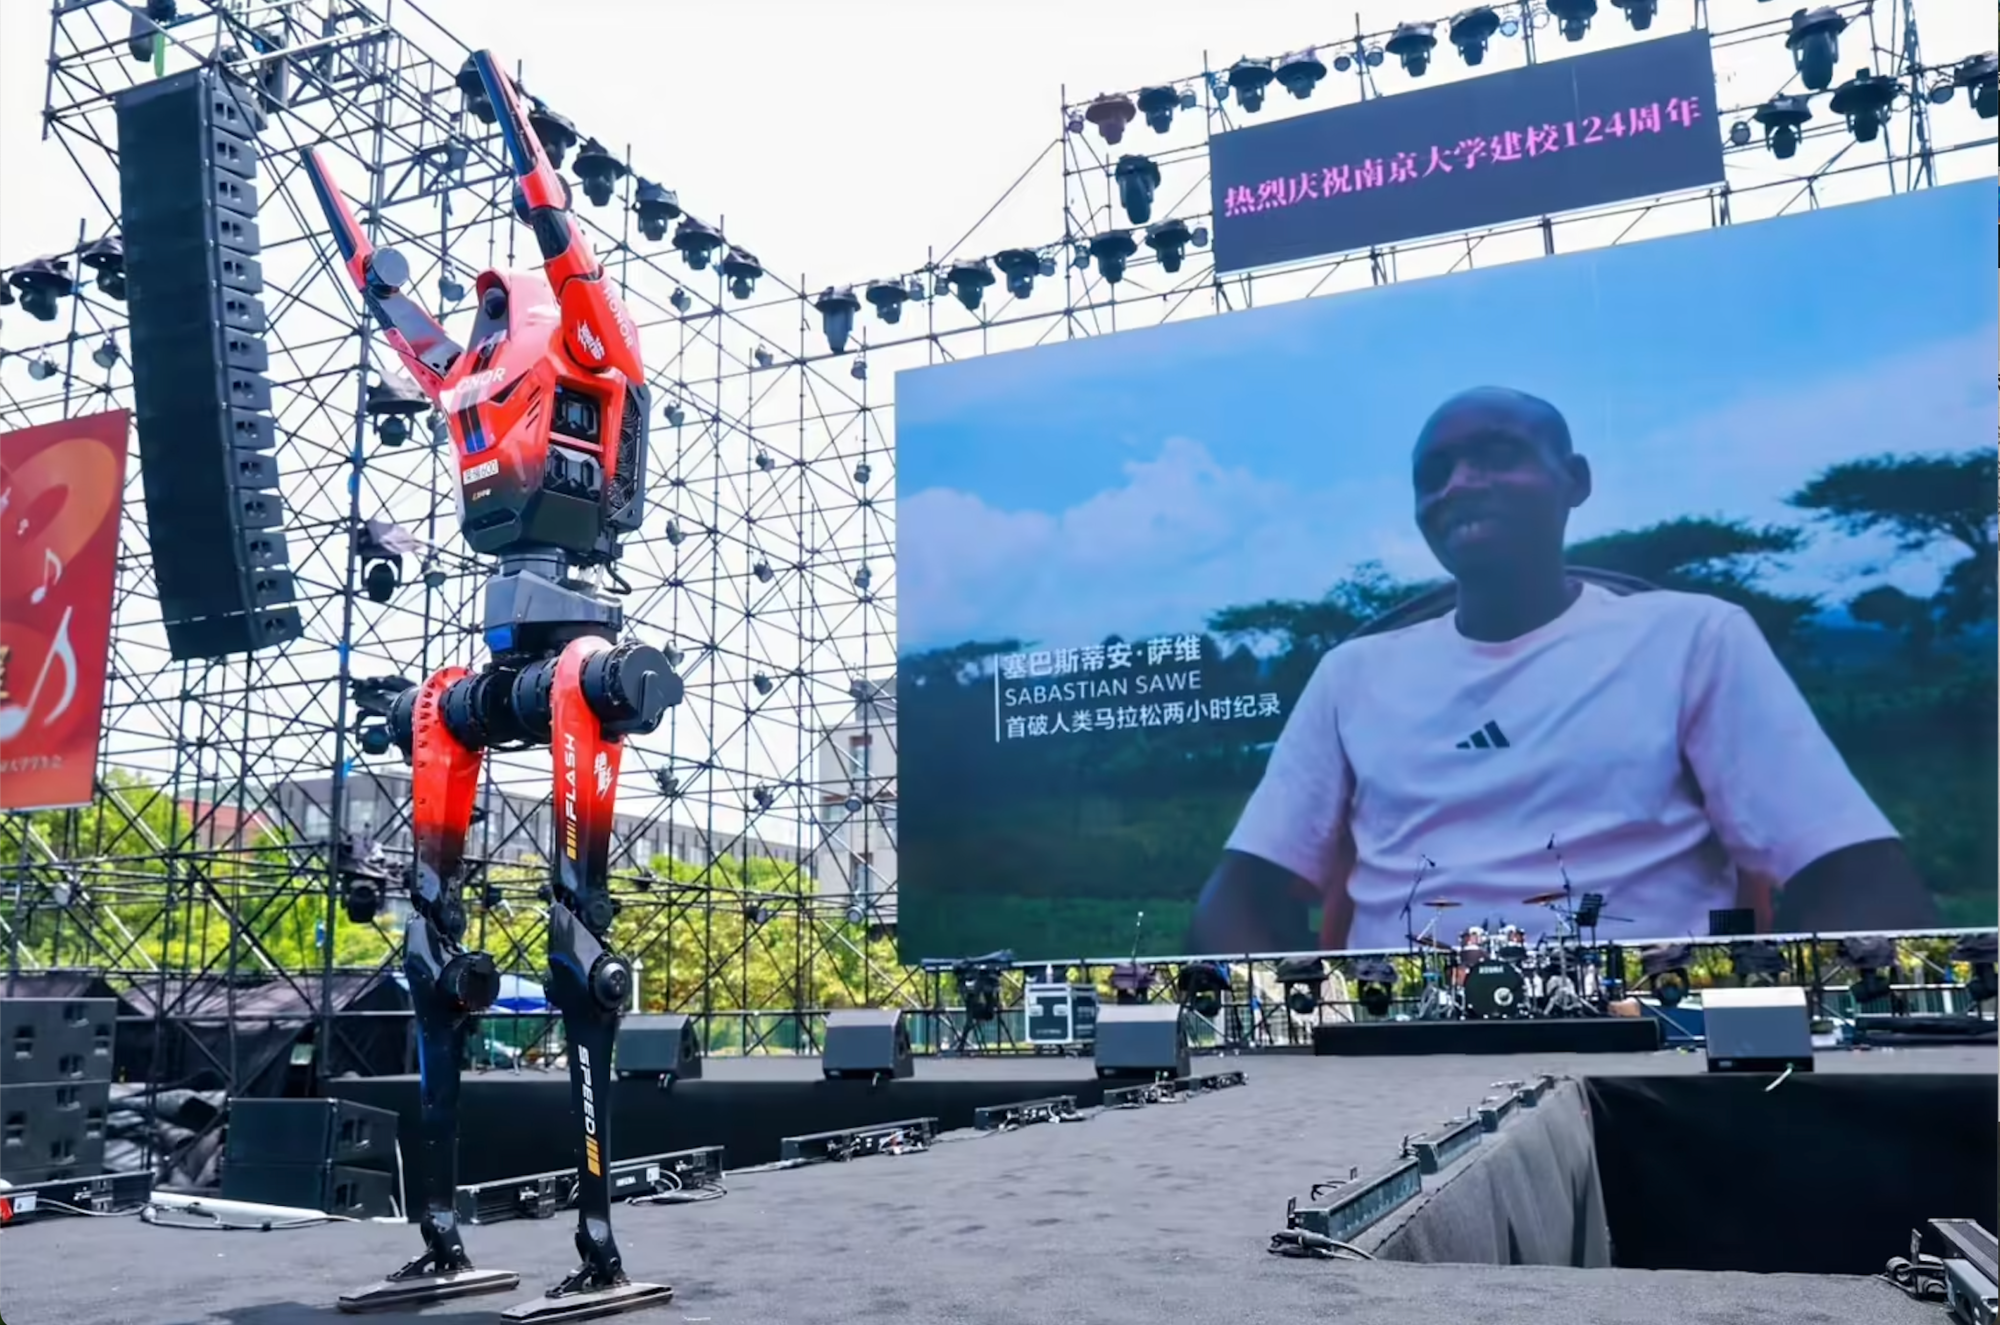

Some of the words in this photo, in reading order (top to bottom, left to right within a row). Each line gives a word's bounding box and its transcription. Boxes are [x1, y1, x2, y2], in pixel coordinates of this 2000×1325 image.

[1225, 96, 1701, 217] 热烈庆祝南京大学建校124周年
[603, 287, 634, 349] HONOR
[449, 367, 506, 396] ONOR
[1003, 635, 1202, 680] 塞巴斯蒂安·萨维
[1005, 679, 1128, 707] SABASTIAN
[1135, 670, 1202, 694] SAWE
[1005, 692, 1281, 739] 首破人类马拉松两小时纪录
[564, 732, 577, 822] FLASH
[578, 1044, 596, 1136] SPEED
